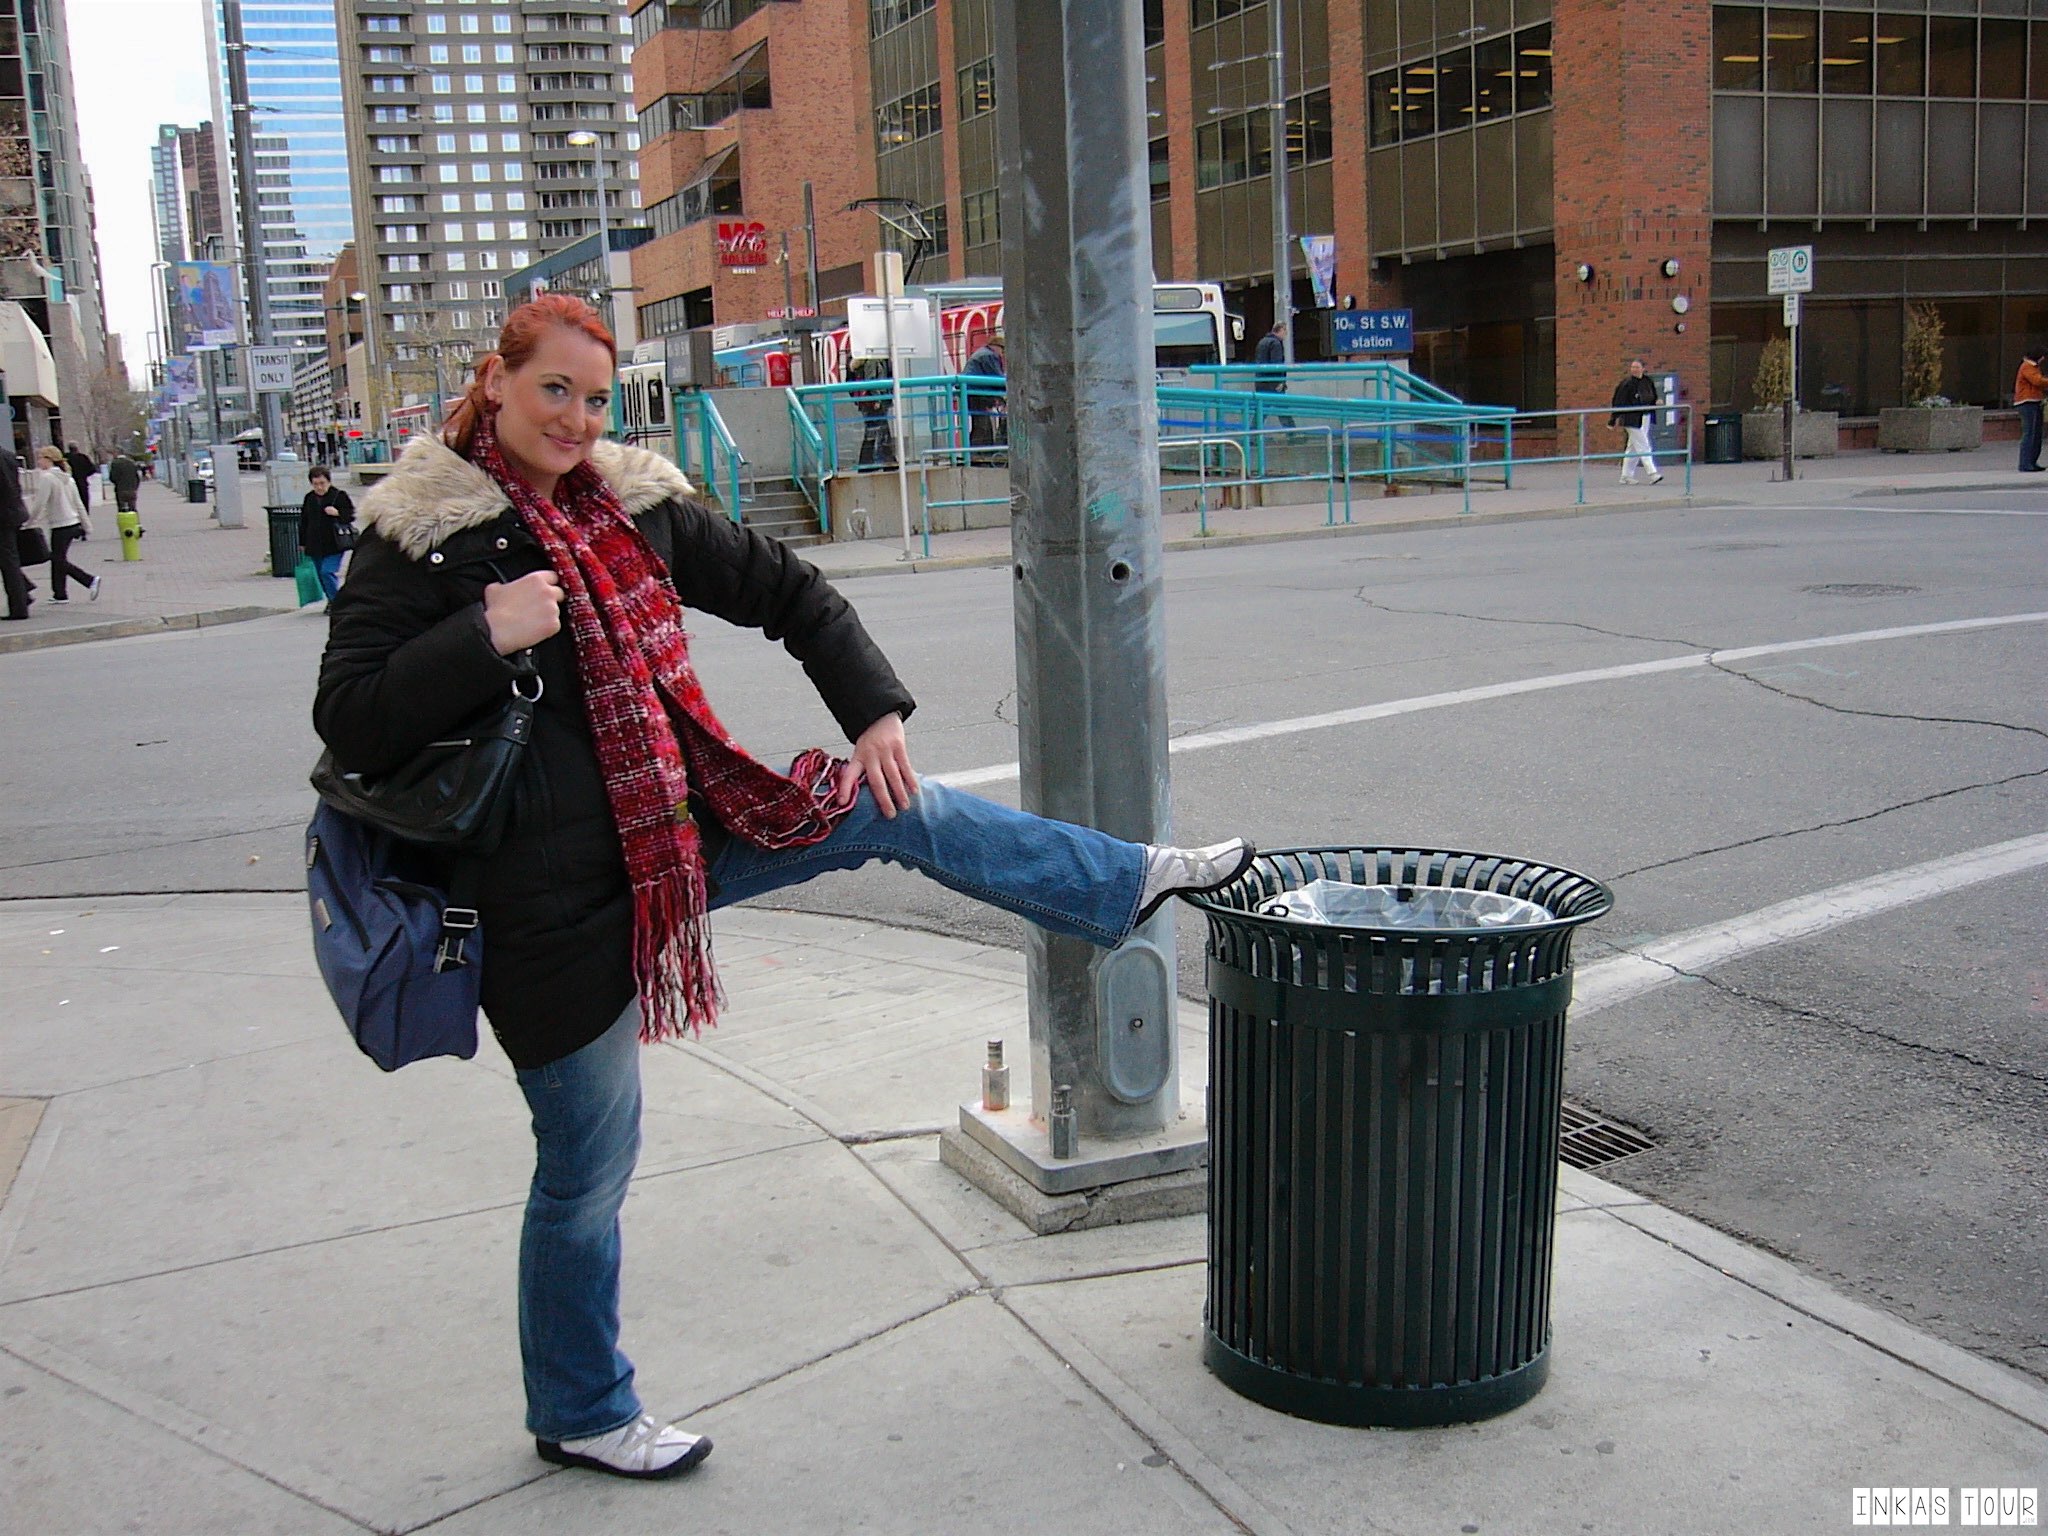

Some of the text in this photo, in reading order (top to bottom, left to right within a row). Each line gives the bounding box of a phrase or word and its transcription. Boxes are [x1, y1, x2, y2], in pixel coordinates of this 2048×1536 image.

[767, 309, 786, 318] HELP
[795, 308, 814, 317] HELP
[1360, 316, 1375, 330] St
[1352, 335, 1393, 348] station
[254, 354, 288, 366] TRANSIT
[260, 372, 285, 384] ONLY
